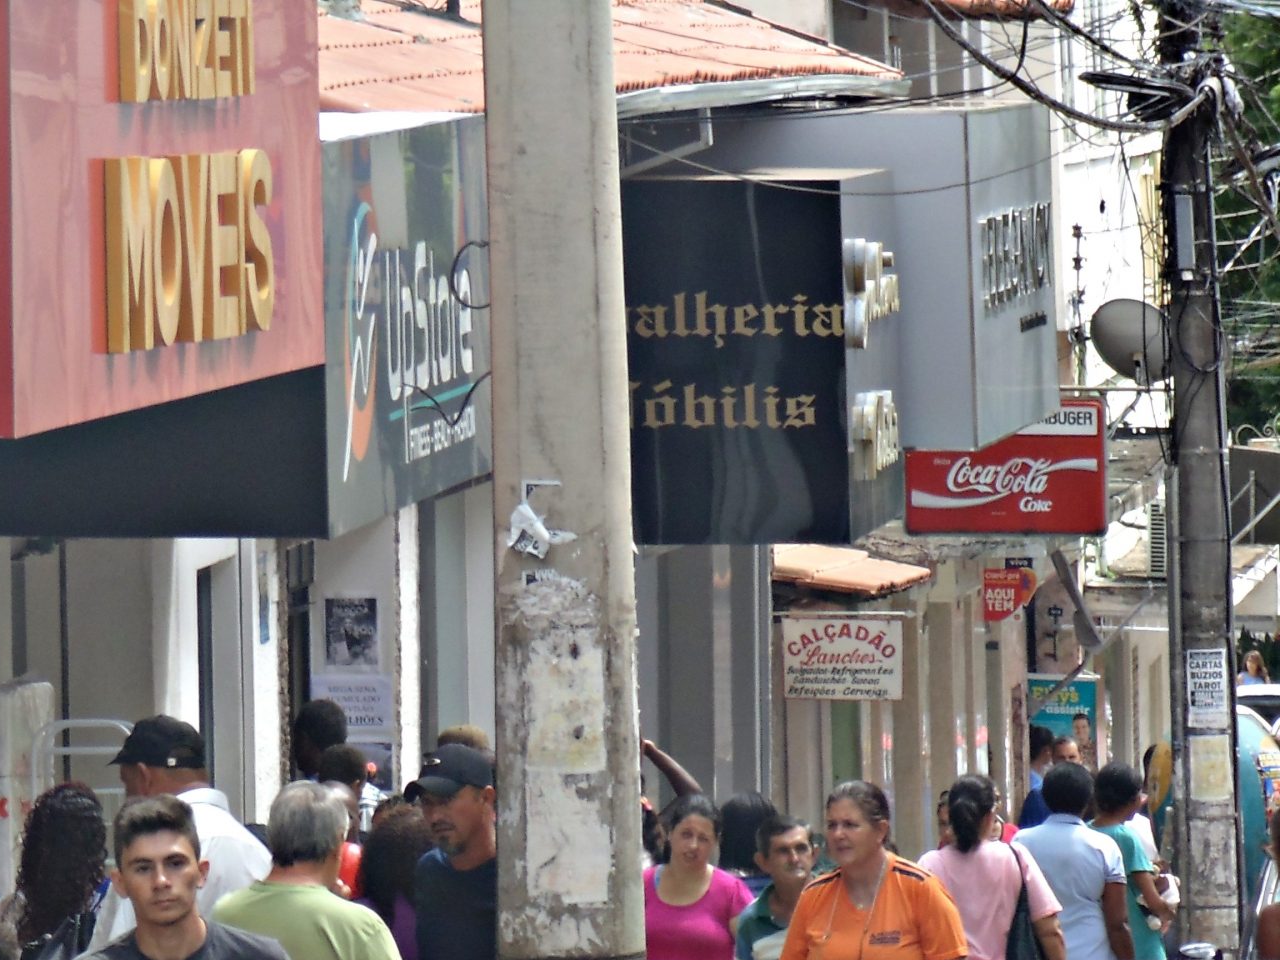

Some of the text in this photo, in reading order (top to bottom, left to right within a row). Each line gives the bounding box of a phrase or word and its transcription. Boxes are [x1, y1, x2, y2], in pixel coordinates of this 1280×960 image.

[108, 149, 274, 353] MOVEIS
[626, 291, 845, 348] alheria
[385, 240, 474, 464] UpStore
[628, 379, 817, 430] óbilis
[1019, 496, 1053, 513] Coke
[985, 588, 1015, 600] AQUI
[988, 600, 1014, 611] TEM
[787, 623, 896, 658] CALÇADÃO
[800, 645, 875, 667] Lanches
[1189, 660, 1223, 669] CARTAS
[1193, 681, 1221, 690] TAROT
